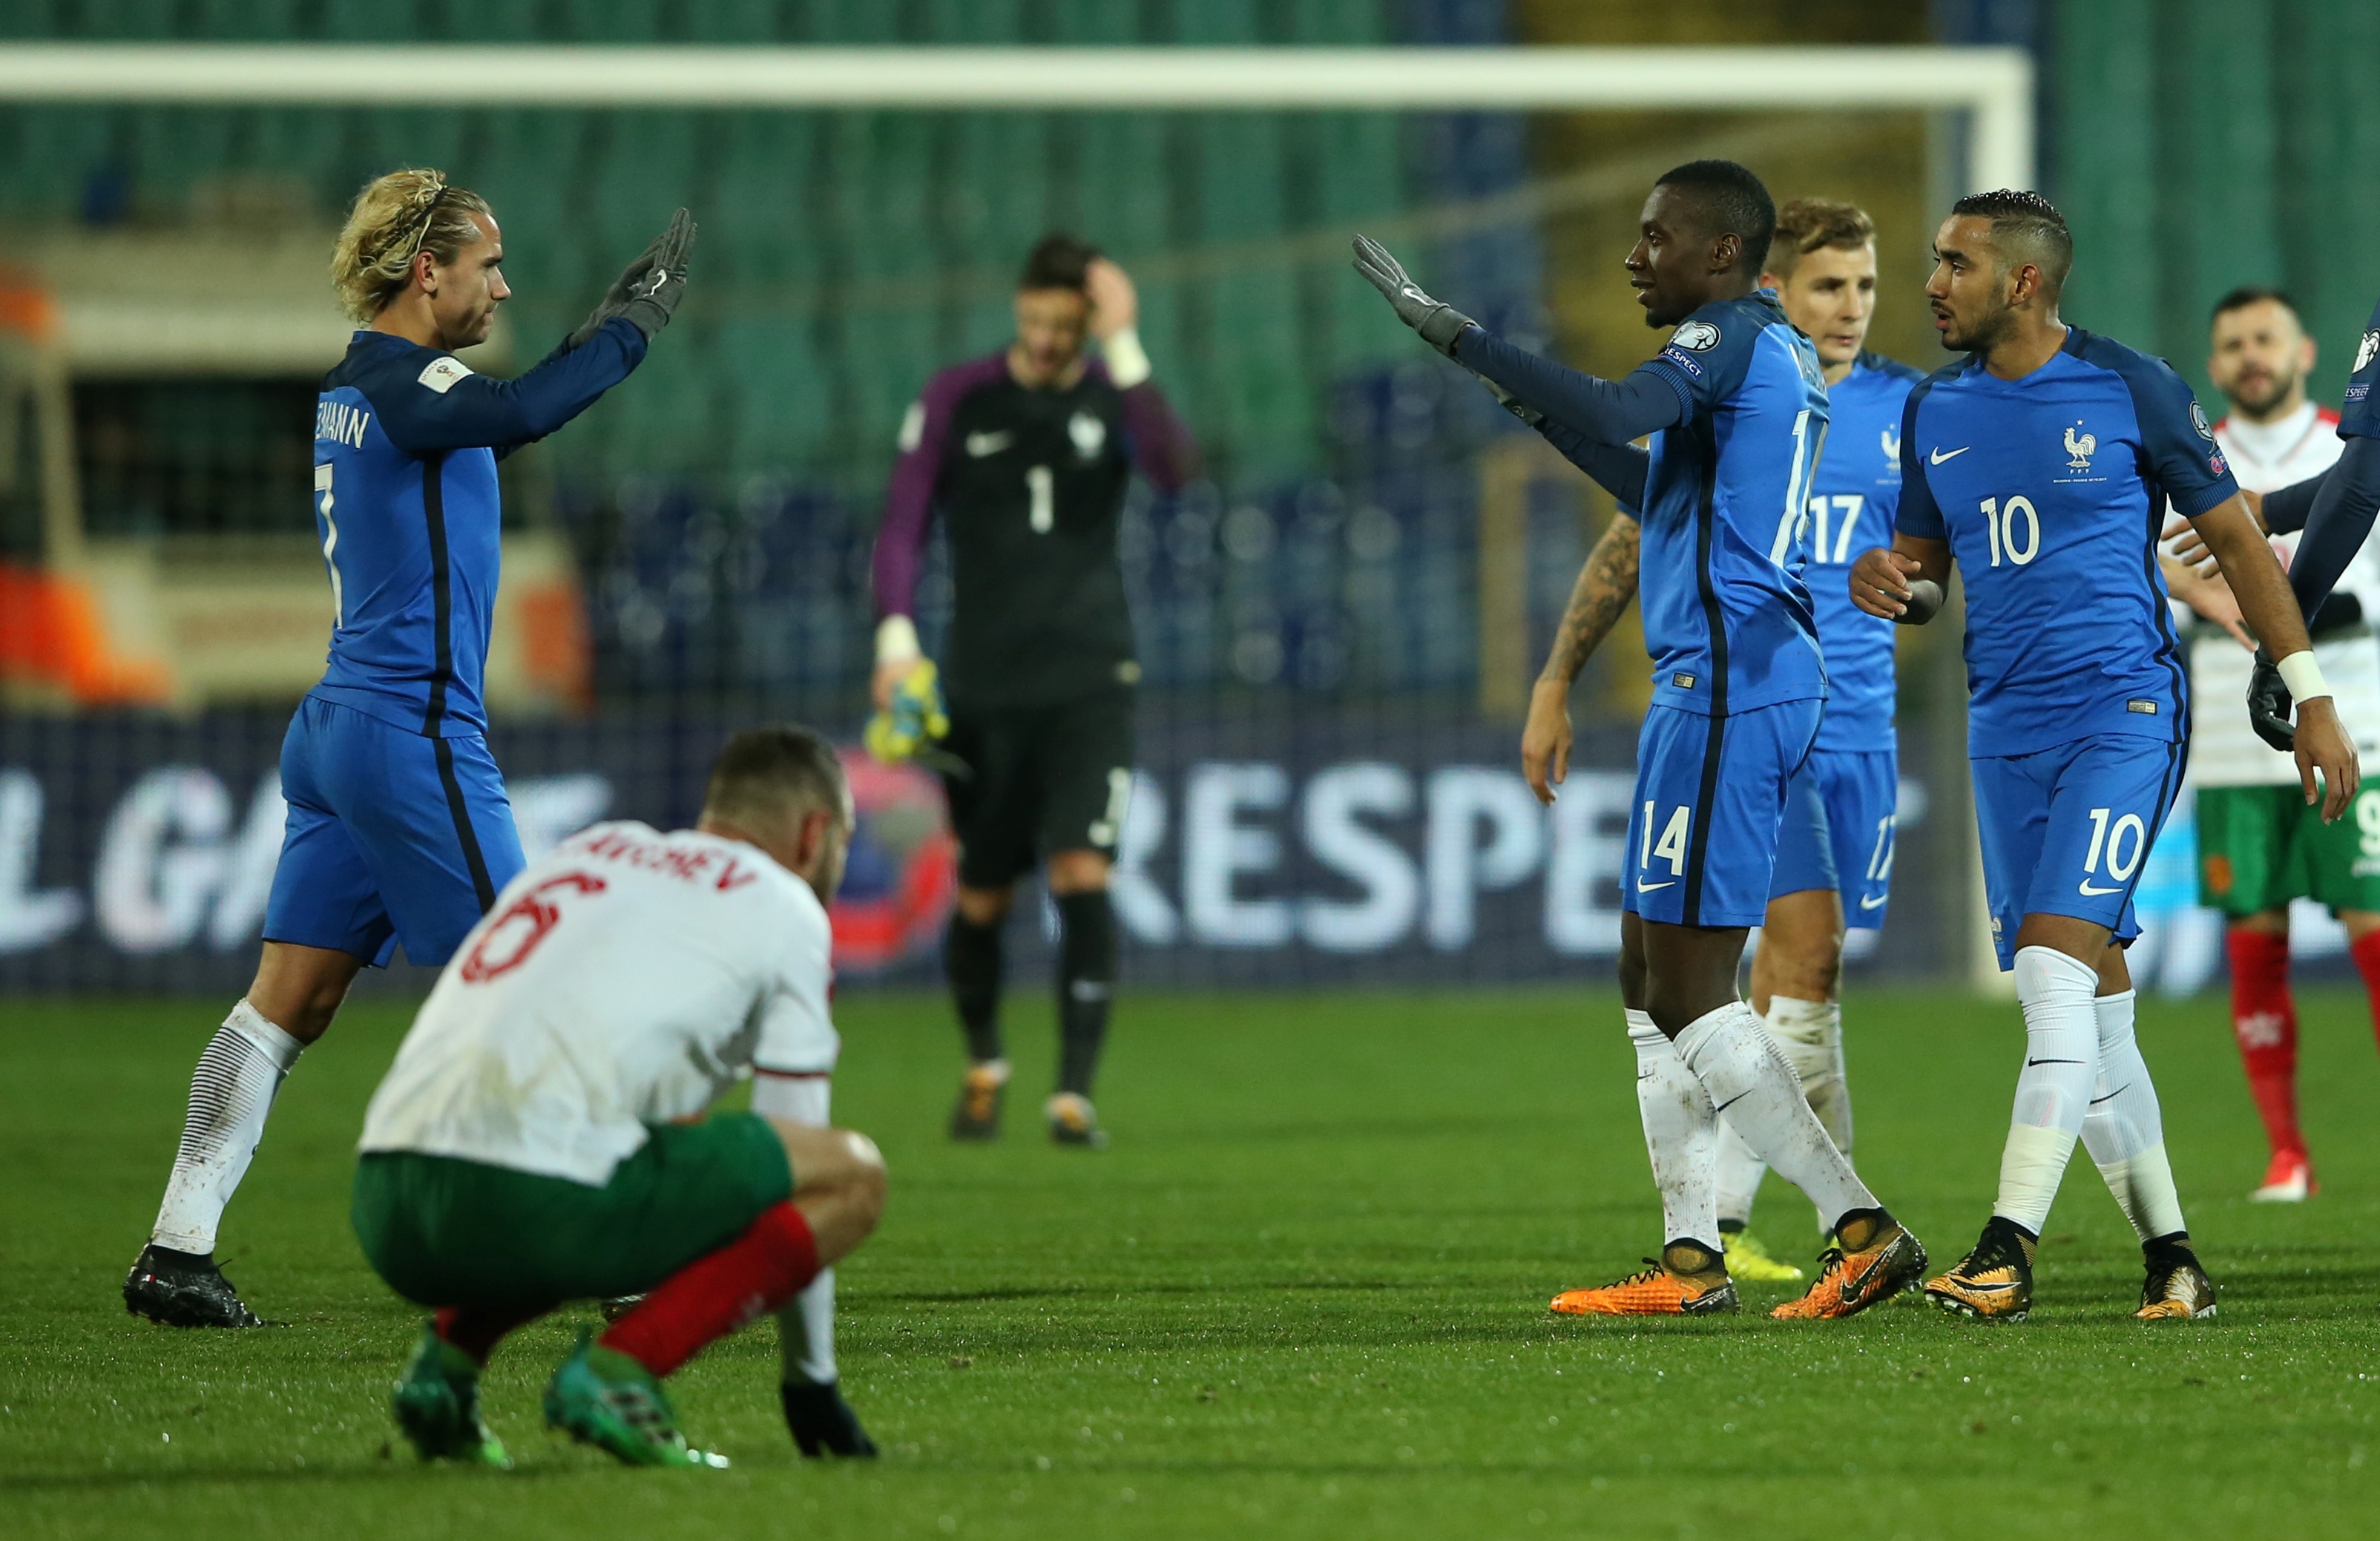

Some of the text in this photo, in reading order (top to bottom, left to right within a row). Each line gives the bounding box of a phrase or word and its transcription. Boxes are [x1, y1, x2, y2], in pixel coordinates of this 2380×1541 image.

[1026, 464, 1054, 535] 1
[1809, 494, 1864, 564] 17
[1980, 495, 2039, 567] 10
[314, 463, 343, 629] 7
[0, 766, 83, 953] L
[1640, 800, 1690, 876] 14
[2083, 807, 2146, 881] 10
[461, 870, 607, 985] 6
